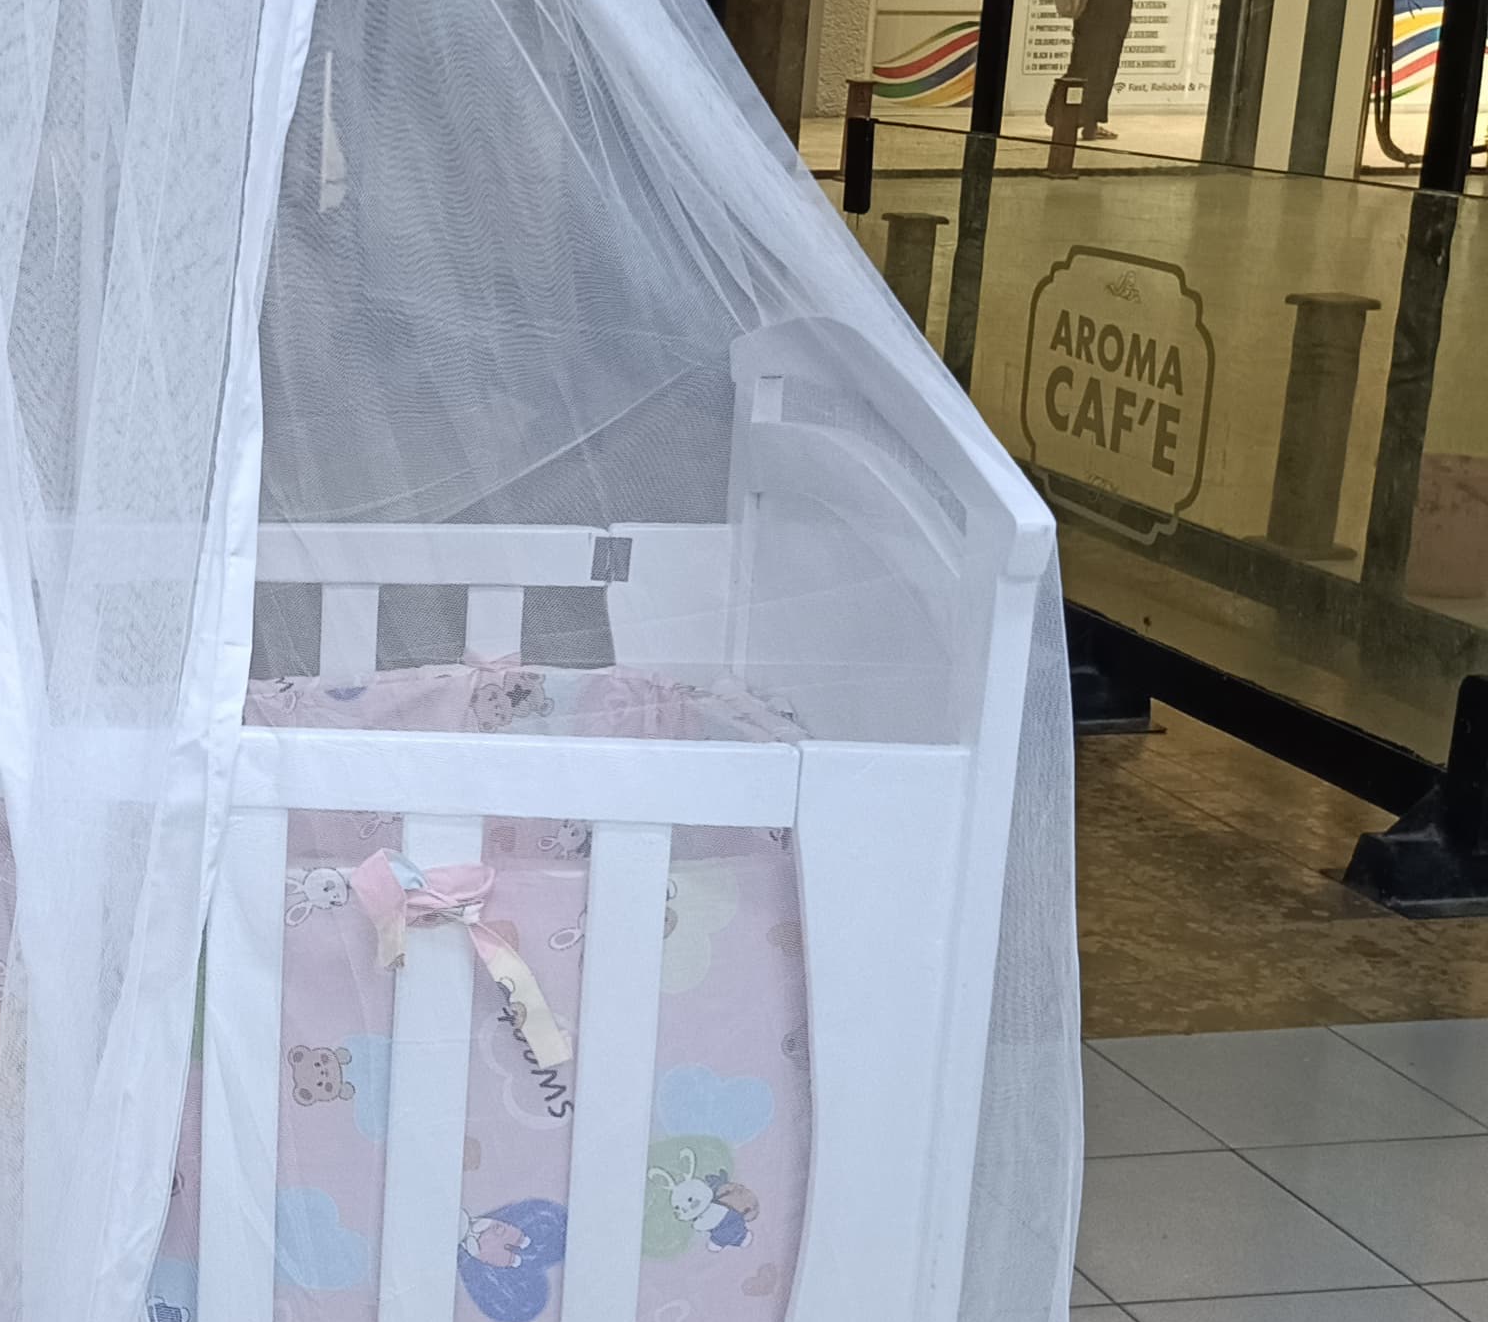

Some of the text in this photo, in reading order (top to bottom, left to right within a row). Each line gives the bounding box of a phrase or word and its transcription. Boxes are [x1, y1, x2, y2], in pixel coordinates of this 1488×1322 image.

[1129, 83, 1148, 93] Fast,
[1152, 82, 1185, 92] Reliable
[1050, 309, 1183, 397] AROMA
